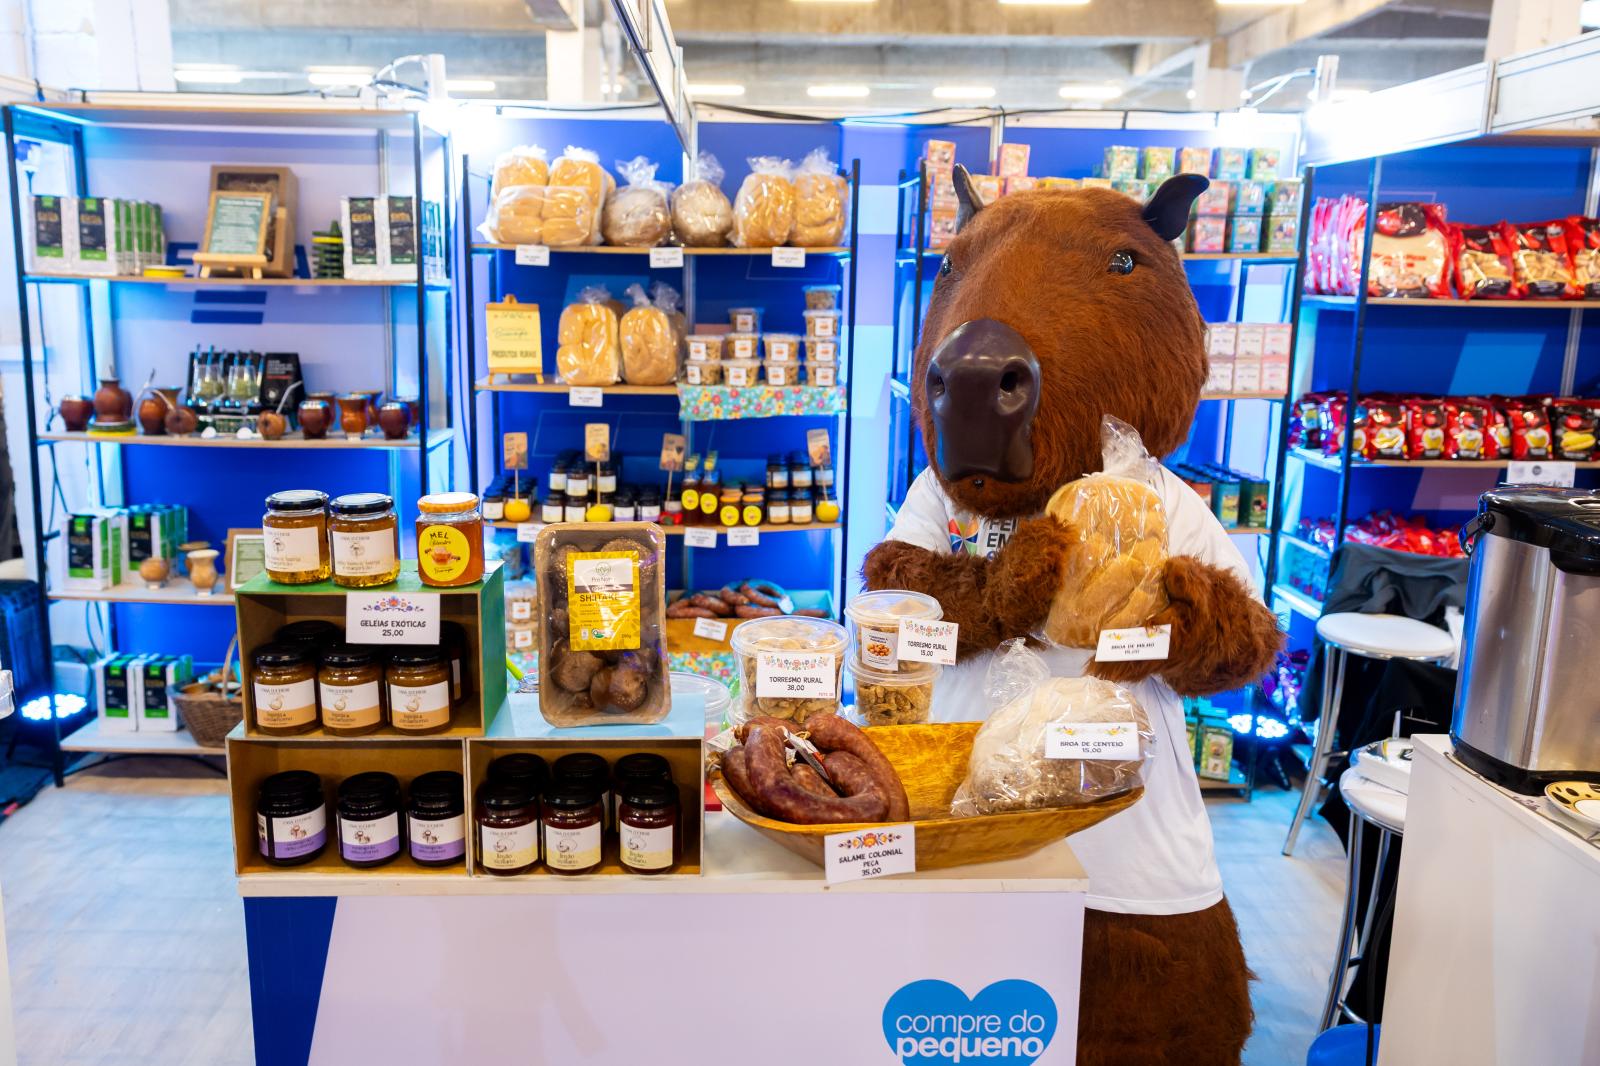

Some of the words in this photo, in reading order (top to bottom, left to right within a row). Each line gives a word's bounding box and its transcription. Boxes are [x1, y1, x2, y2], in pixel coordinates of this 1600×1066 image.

[382, 629, 404, 637] 25,00
[907, 641, 932, 649] TORRESMO
[839, 853, 866, 864] SALAME
[868, 848, 903, 859] COLONIAL
[862, 867, 882, 876] 35,00
[896, 1014, 1001, 1038] compre
[1008, 1009, 1045, 1034] do
[896, 1036, 1045, 1063] pequeno
